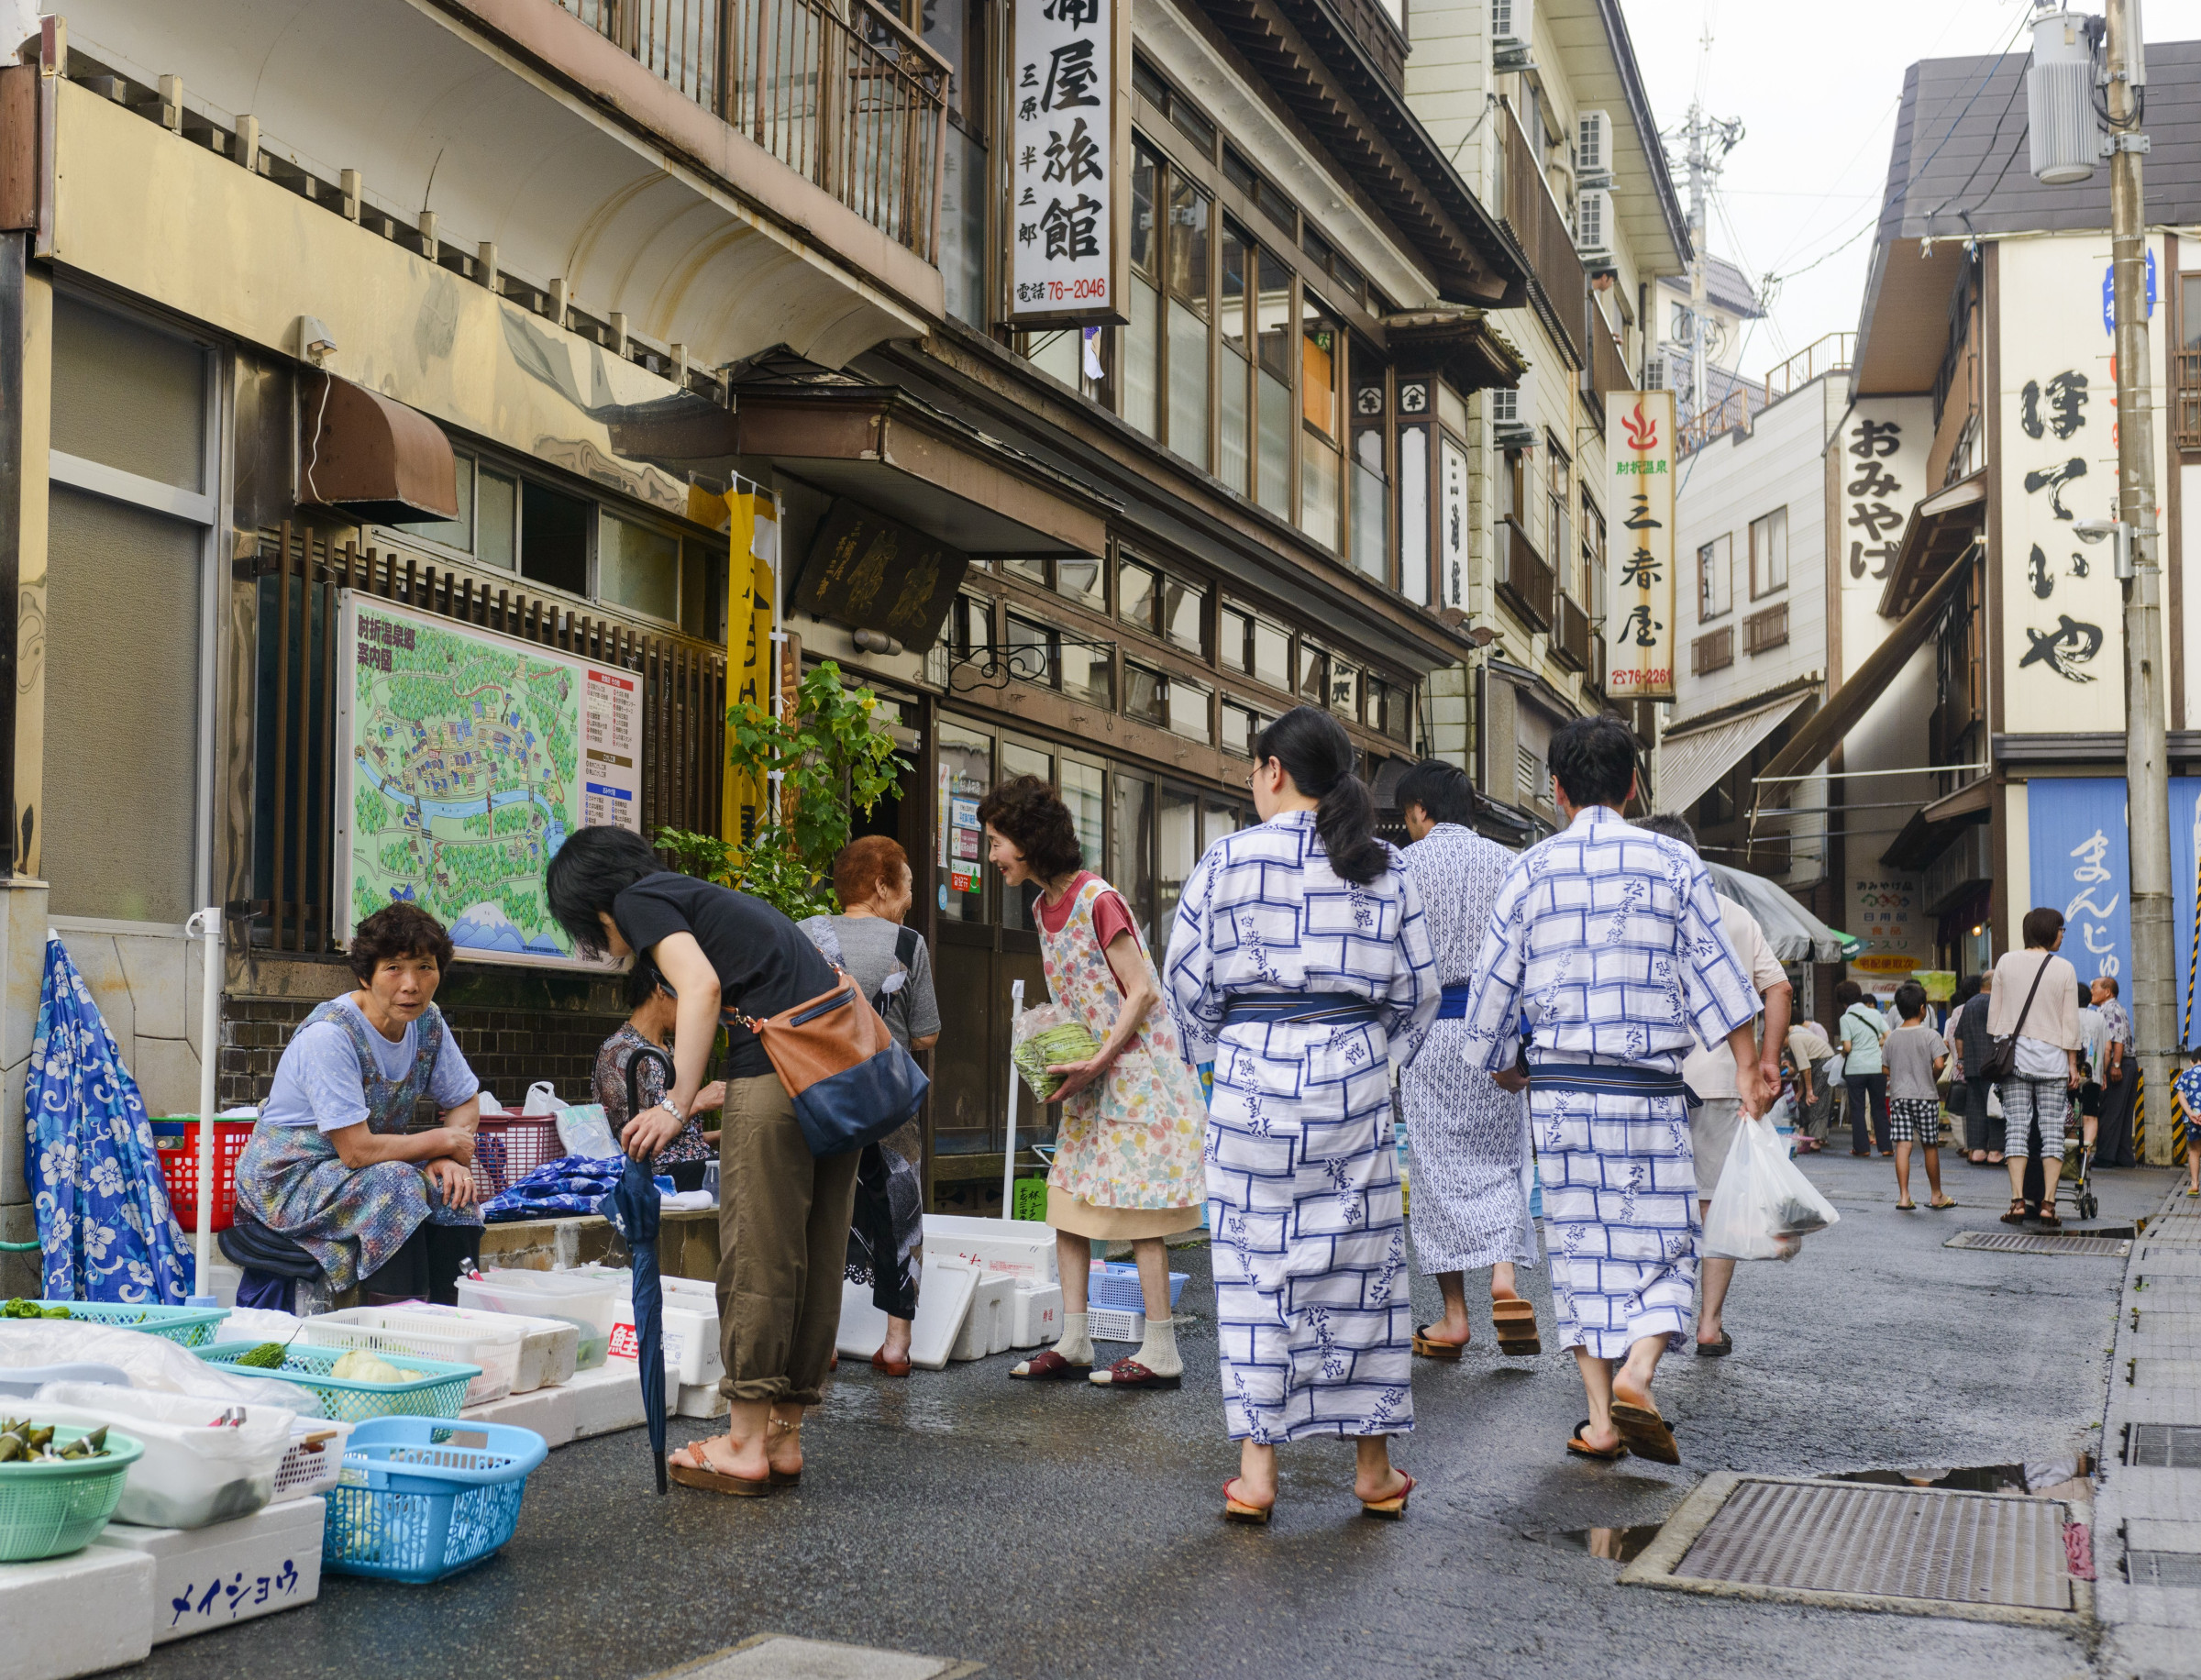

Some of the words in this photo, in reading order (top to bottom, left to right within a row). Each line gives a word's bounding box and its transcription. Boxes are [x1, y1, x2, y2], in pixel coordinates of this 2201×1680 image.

[1017, 282, 1045, 303] 電話
[1047, 278, 1106, 301] 76-2046
[1616, 460, 1668, 475] 肘折温泉
[1848, 419, 1903, 580] おみやげ
[2019, 370, 2103, 684] ほていや
[1618, 494, 1663, 647] 三春屋
[358, 614, 415, 651] 肘折温泉郷
[358, 642, 392, 672] 案内図
[1628, 669, 1672, 685] 76-2261
[1864, 912, 1908, 923] 日用品
[2065, 829, 2119, 986] まんじゅ
[1872, 926, 1902, 936] 食品
[1859, 958, 1914, 969] 宅配便取次
[608, 1325, 638, 1356] 鮭
[171, 1559, 299, 1625] メイショウ
